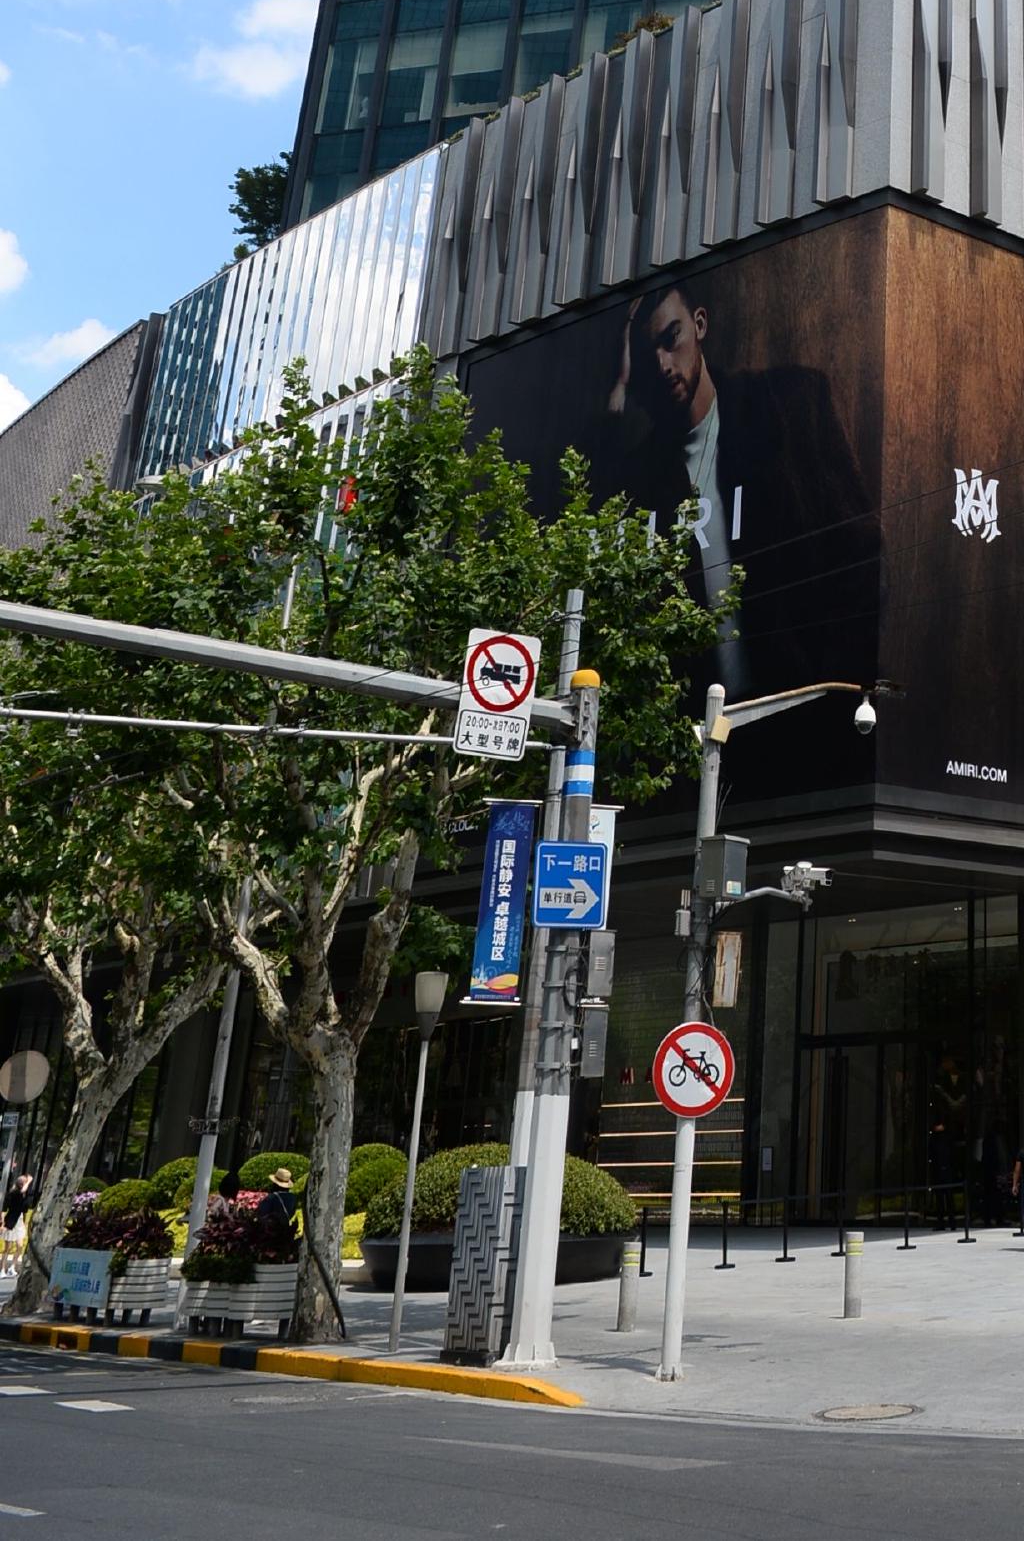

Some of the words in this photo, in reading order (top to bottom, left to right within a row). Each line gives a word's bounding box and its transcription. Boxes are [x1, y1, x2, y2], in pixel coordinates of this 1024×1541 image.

[460, 730, 520, 752] 大型号牌
[946, 760, 1008, 783] AMIRI.COM
[498, 840, 516, 897] 国际静安
[542, 854, 601, 872] 下一路口
[544, 891, 572, 904] 单行道
[491, 902, 510, 961] 卓越城区
